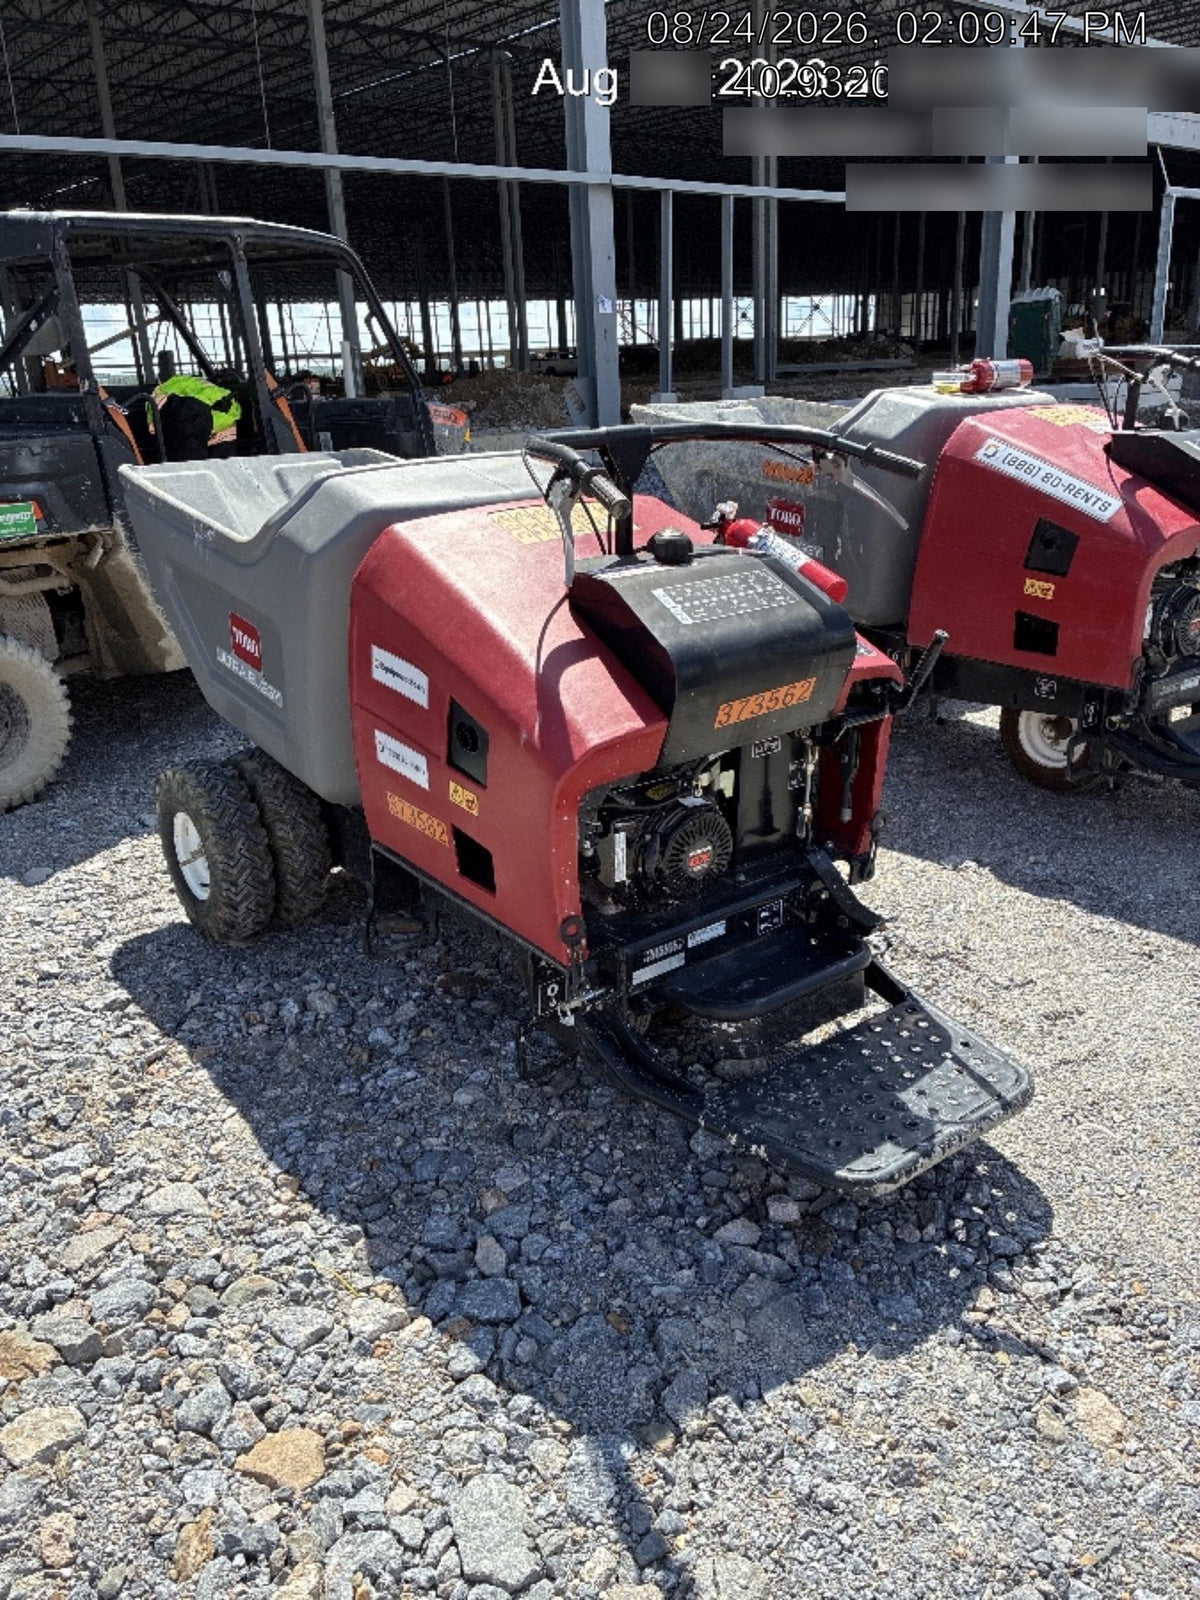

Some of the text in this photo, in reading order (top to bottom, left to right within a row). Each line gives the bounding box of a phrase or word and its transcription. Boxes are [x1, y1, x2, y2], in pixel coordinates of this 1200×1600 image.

[1041, 471, 1112, 513] 80-RENTS
[769, 507, 801, 526] TORO
[717, 680, 813, 727] 373562
